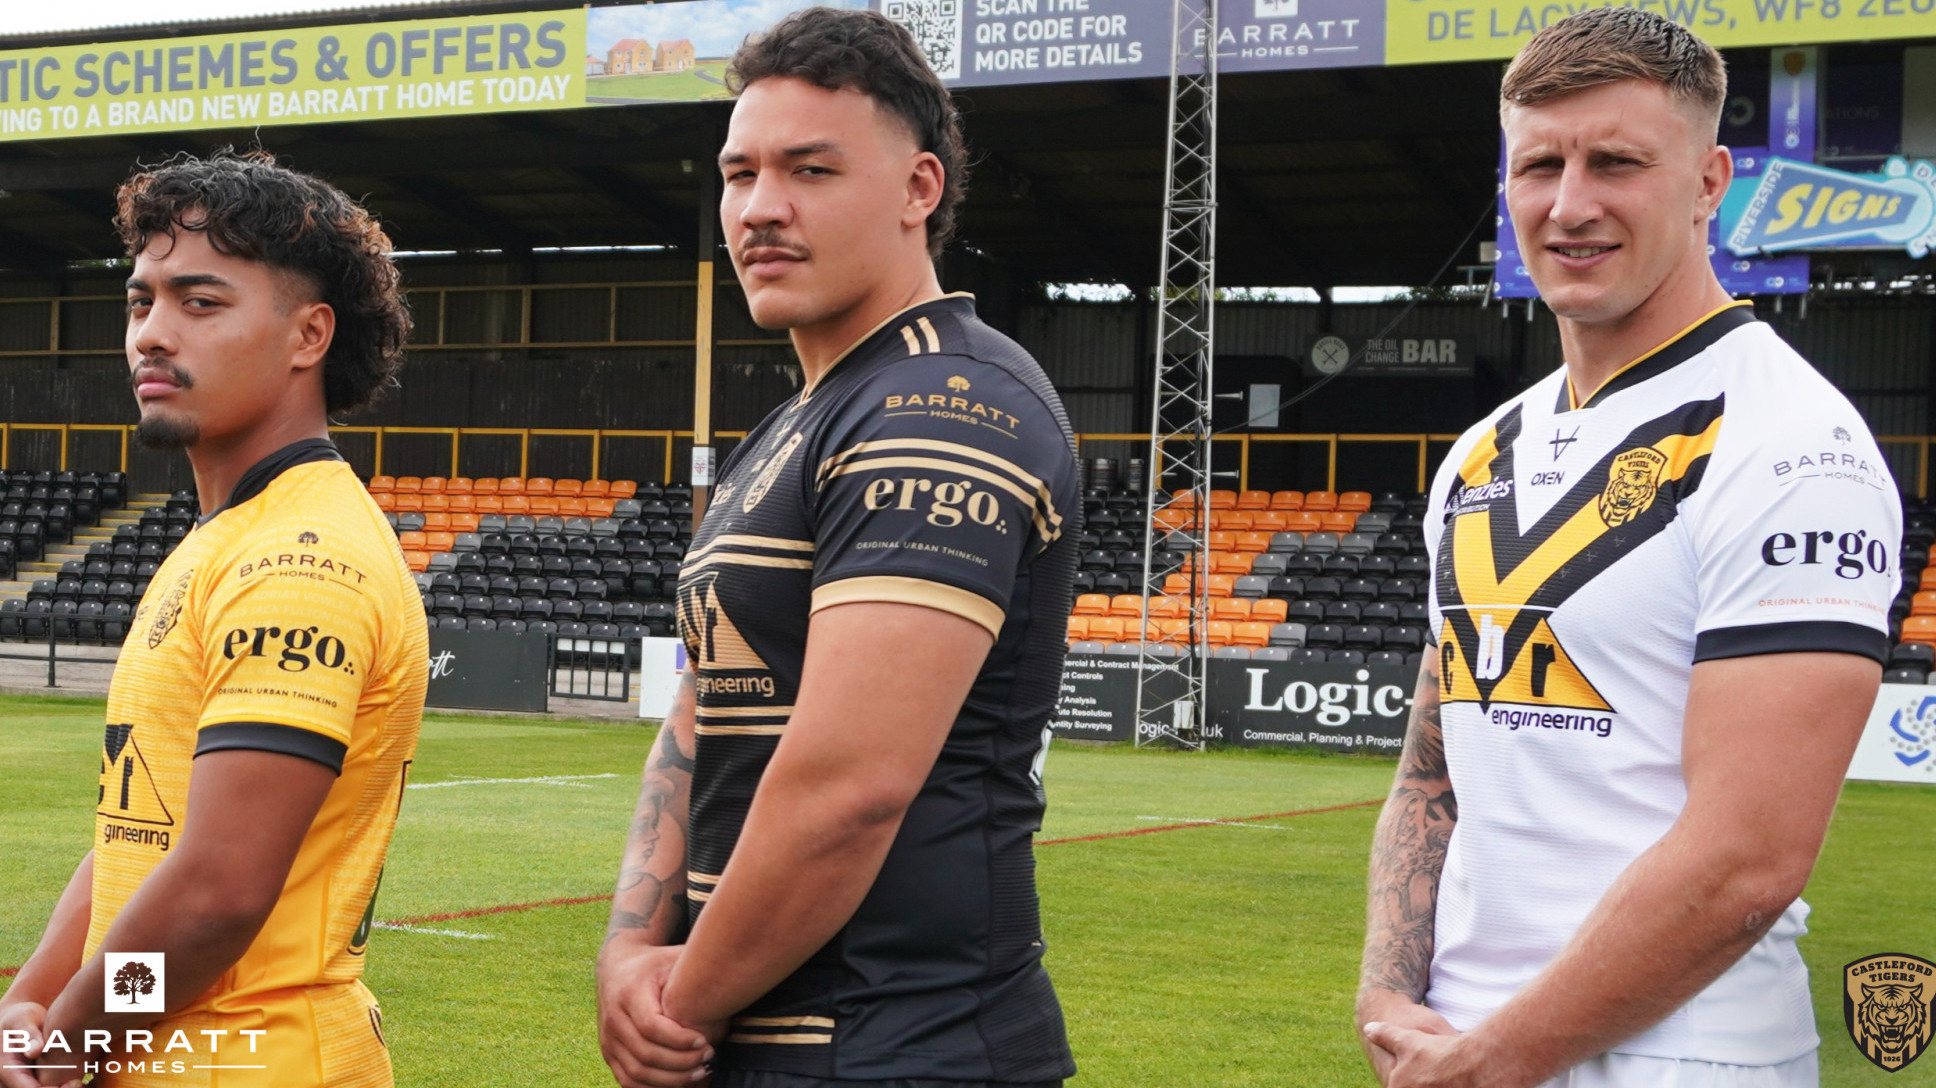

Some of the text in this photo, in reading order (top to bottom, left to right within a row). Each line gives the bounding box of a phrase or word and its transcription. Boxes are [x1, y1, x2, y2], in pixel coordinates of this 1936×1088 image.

[976, 0, 1037, 17] SCAN
[1427, 9, 1475, 41] DE
[1489, 0, 1587, 38] LAC
[1754, 0, 1841, 23] WF8
[975, 14, 1127, 45] QR CODE FOR
[975, 41, 1143, 72] MORE DETAILS
[1241, 45, 1309, 58] HOMES
[0, 20, 566, 103] TIC SCHEMES & OFFERS
[0, 73, 572, 134] ING TO A BRAND NEW BARRATT HOME TODAY
[1732, 160, 1785, 248] RIVERSIDE
[1764, 183, 1902, 236] SIGNS
[1367, 338, 1398, 351] THE OIL
[1402, 338, 1457, 364] BAR
[1365, 351, 1400, 364] CHANGE
[885, 393, 1020, 430] BARRATT
[929, 409, 979, 425] HOMES
[1824, 471, 1866, 485] HOMES
[856, 540, 989, 568] ORIGINAL URBAN THINKING
[239, 553, 367, 584] BARRATT
[279, 570, 326, 581] HOMES
[1757, 598, 1812, 607] ORIGINAL
[1815, 598, 1851, 607] URBAN
[1089, 659, 1096, 667] &
[1096, 660, 1130, 670] Contract
[1131, 661, 1180, 672] Mnagement
[1070, 671, 1104, 681] Controls
[217, 687, 338, 709] ORIGINAL URBAN THINKING
[1063, 695, 1097, 706] Analysis
[1071, 709, 1113, 719] Resolution
[1491, 707, 1612, 738] engineering
[1073, 721, 1113, 732] Surveying
[1308, 732, 1353, 747] Planning
[1355, 734, 1364, 745] &
[1365, 734, 1403, 748] Project
